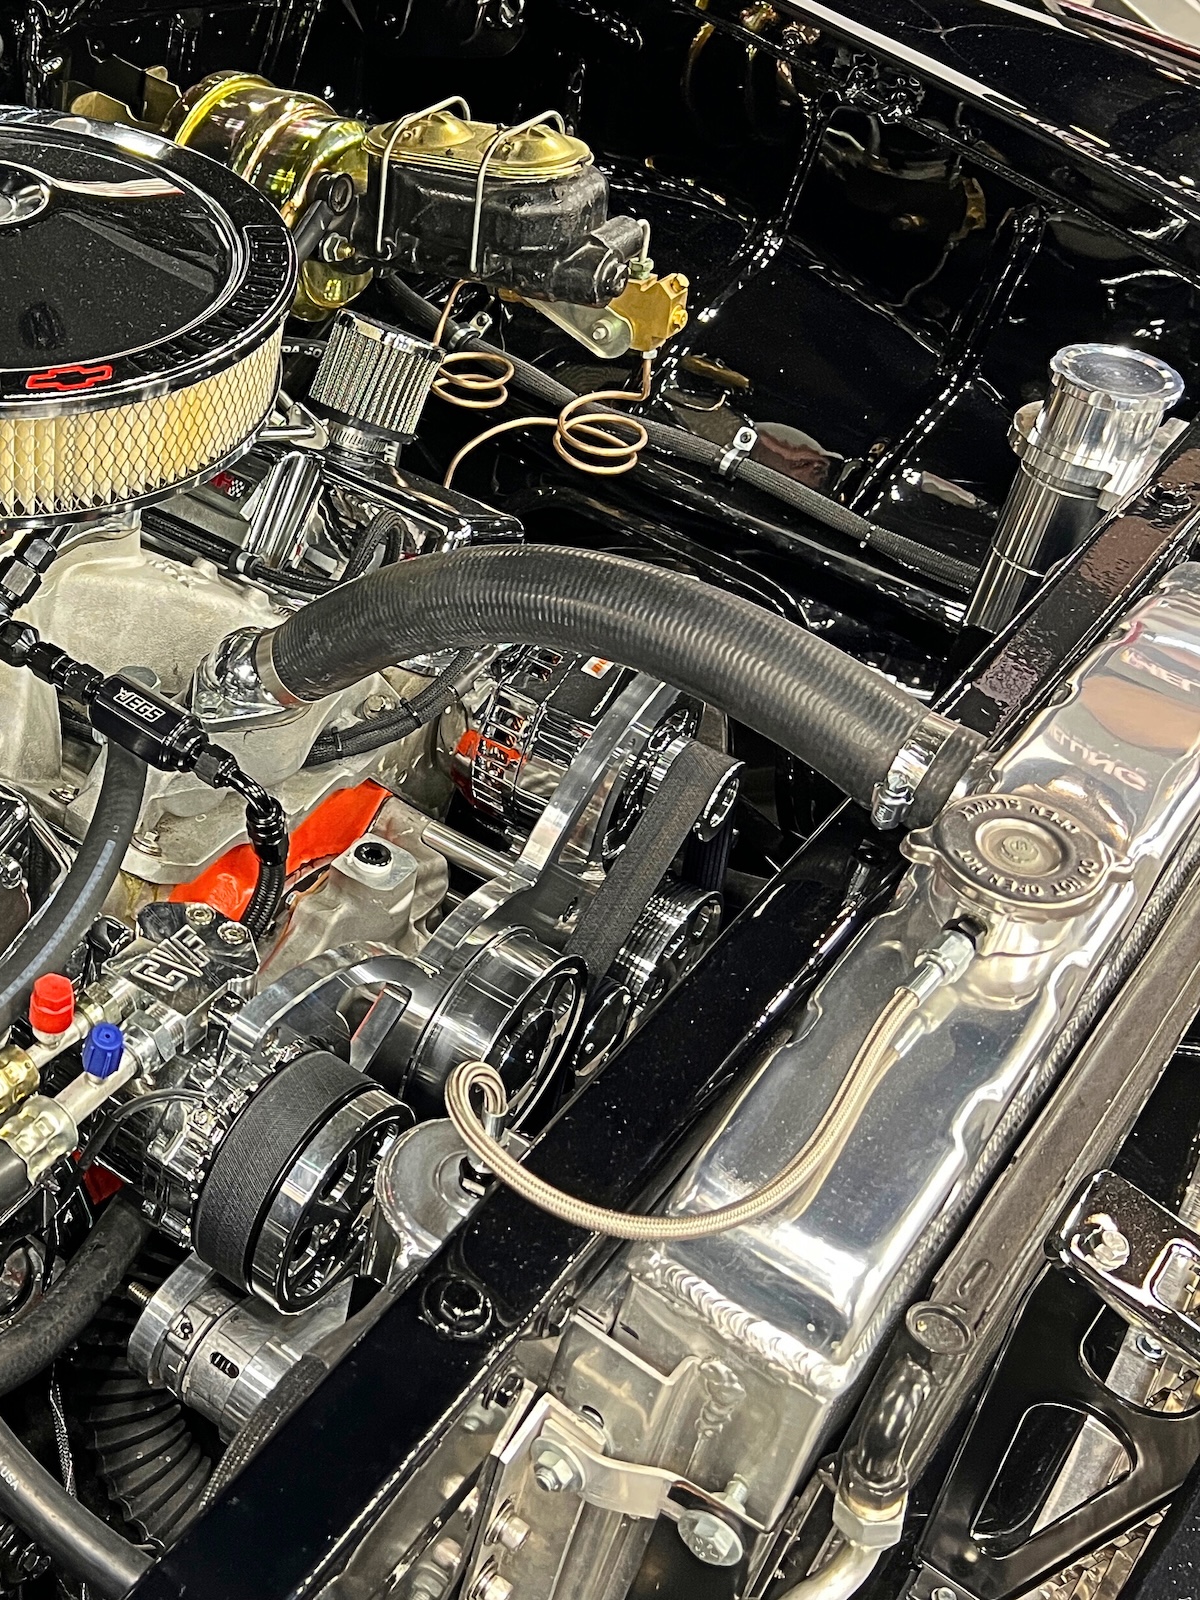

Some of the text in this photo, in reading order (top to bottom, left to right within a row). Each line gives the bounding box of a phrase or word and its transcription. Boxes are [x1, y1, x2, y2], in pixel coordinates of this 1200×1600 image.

[113, 687, 167, 723] JEGS
[130, 924, 211, 992] CVF
[0, 1465, 20, 1492] USA
